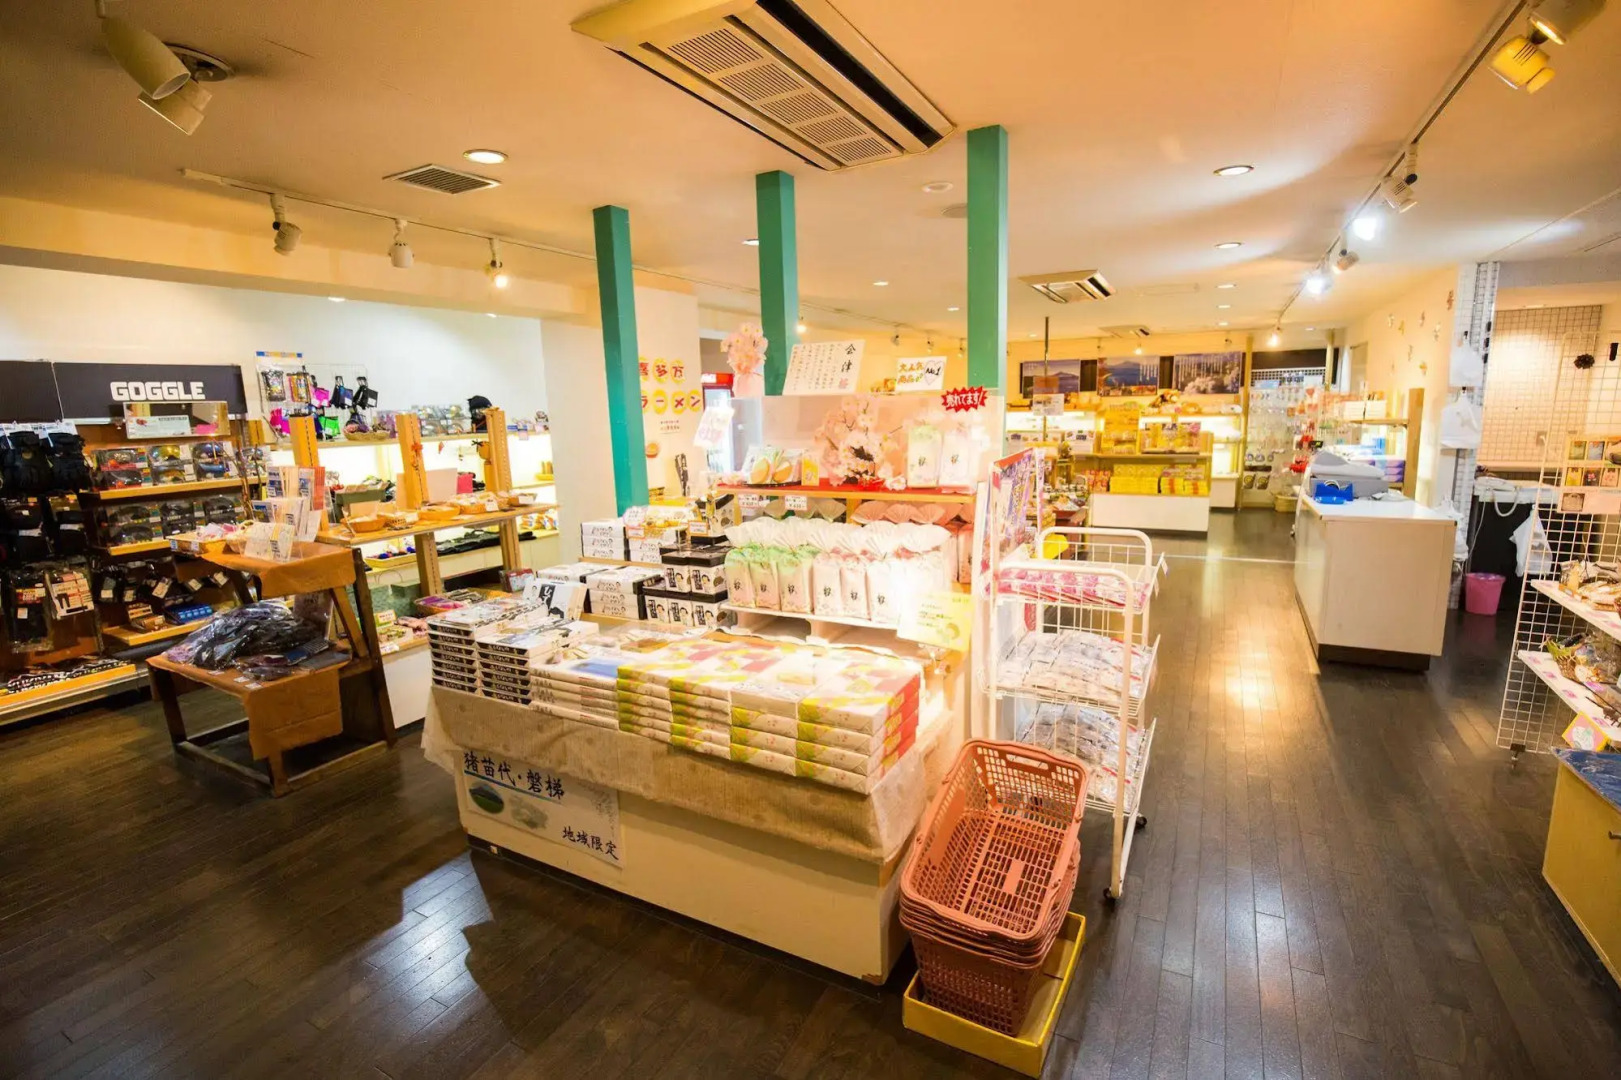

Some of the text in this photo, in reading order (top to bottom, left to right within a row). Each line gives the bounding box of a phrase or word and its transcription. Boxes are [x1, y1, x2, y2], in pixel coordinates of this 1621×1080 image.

[841, 344, 856, 372] 会津
[110, 381, 206, 401] GOGGLE
[641, 395, 701, 409] ラーメン
[562, 826, 619, 861] 地域限定
